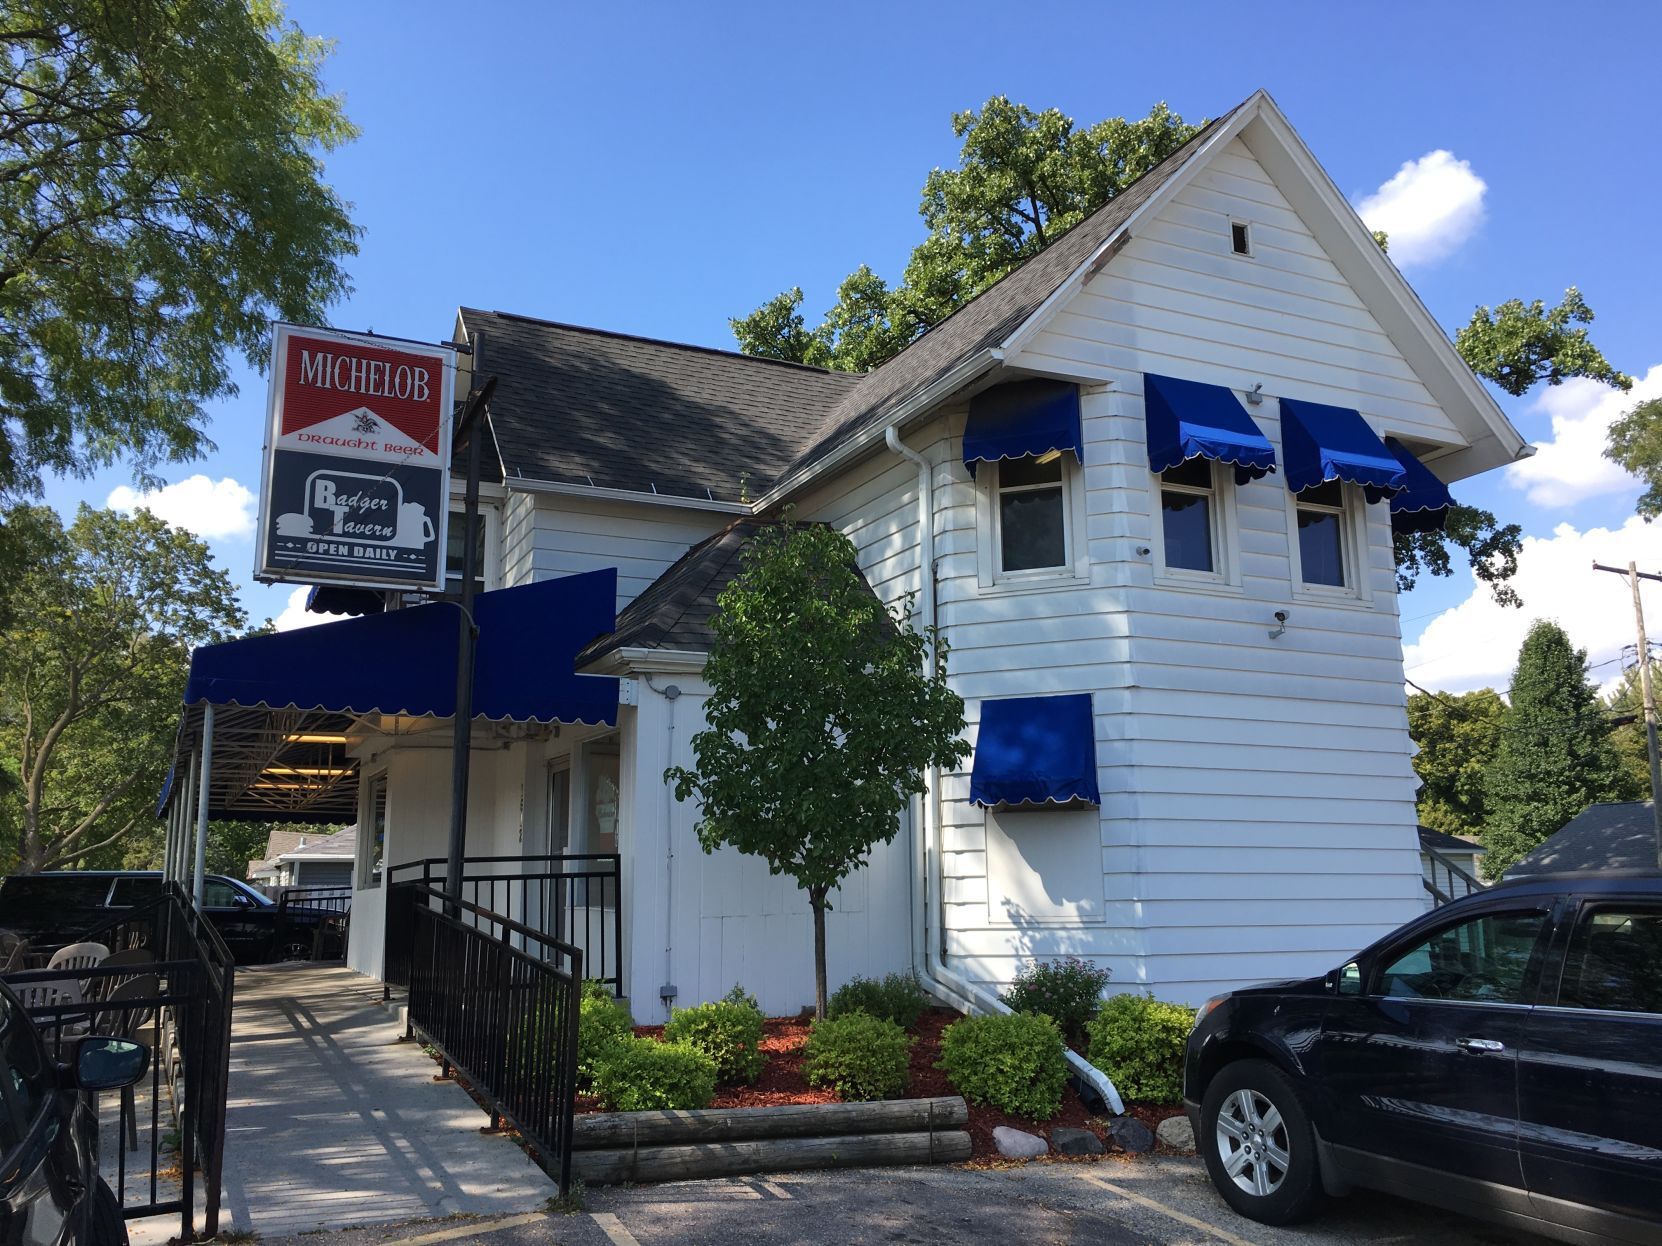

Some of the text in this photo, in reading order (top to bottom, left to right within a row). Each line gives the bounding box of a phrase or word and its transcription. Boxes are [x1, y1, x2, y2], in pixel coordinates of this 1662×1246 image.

[298, 349, 430, 401] MICHELOB
[314, 478, 389, 514] Badger
[329, 504, 393, 537] Tavern
[306, 541, 398, 560] OPEN DAILY
